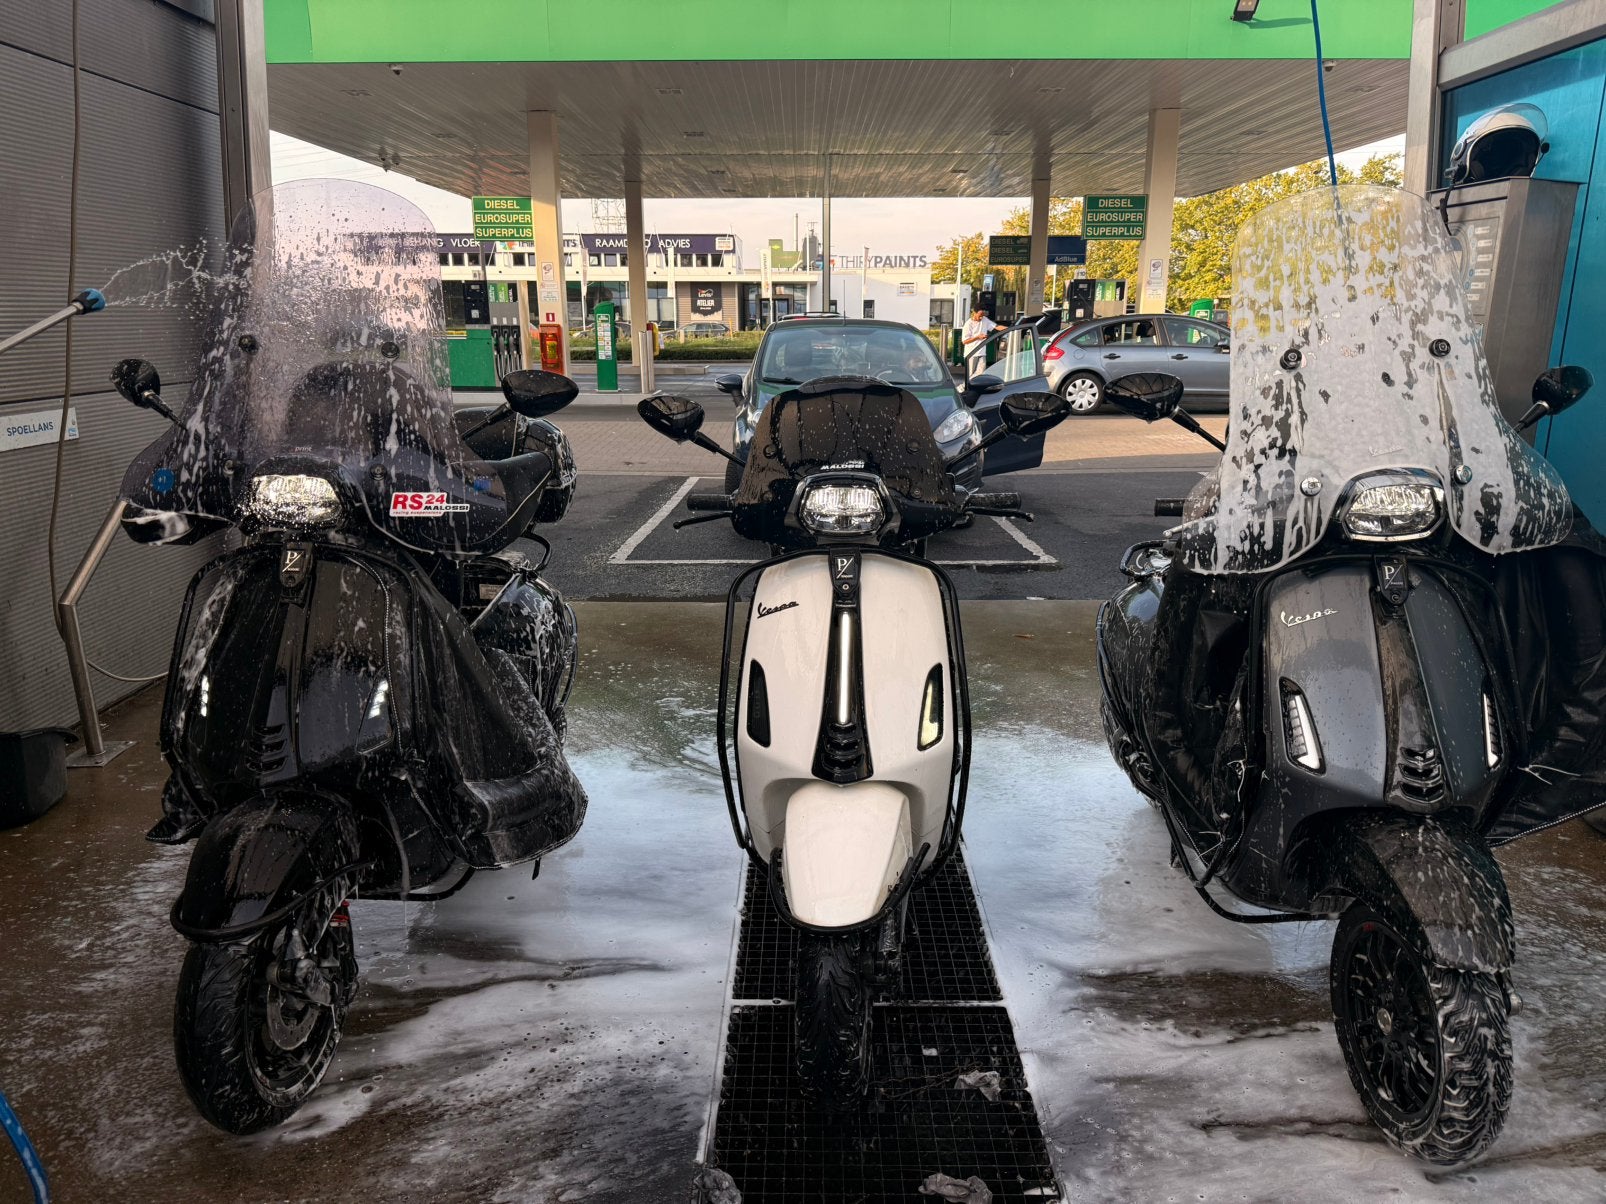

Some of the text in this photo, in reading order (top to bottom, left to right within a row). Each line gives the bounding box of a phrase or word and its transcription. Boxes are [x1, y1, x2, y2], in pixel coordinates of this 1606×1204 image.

[484, 200, 520, 209] DIESEL
[1098, 199, 1134, 208] DIESEL
[475, 214, 531, 223] EUROSUPER
[1087, 212, 1144, 222] EUROSUPER
[476, 228, 533, 237] SUPERPLUS
[1086, 226, 1143, 236] SUPERPLUS
[659, 239, 691, 249] ADVIES
[991, 237, 1014, 245] DIESEL
[990, 255, 1028, 264] EUROSUPER
[1054, 256, 1078, 264] AdBlue
[7, 422, 54, 436] SPOELLANS
[423, 503, 469, 511] MALOSSI
[757, 602, 799, 618] Vespa
[1280, 607, 1339, 627] Vespa
